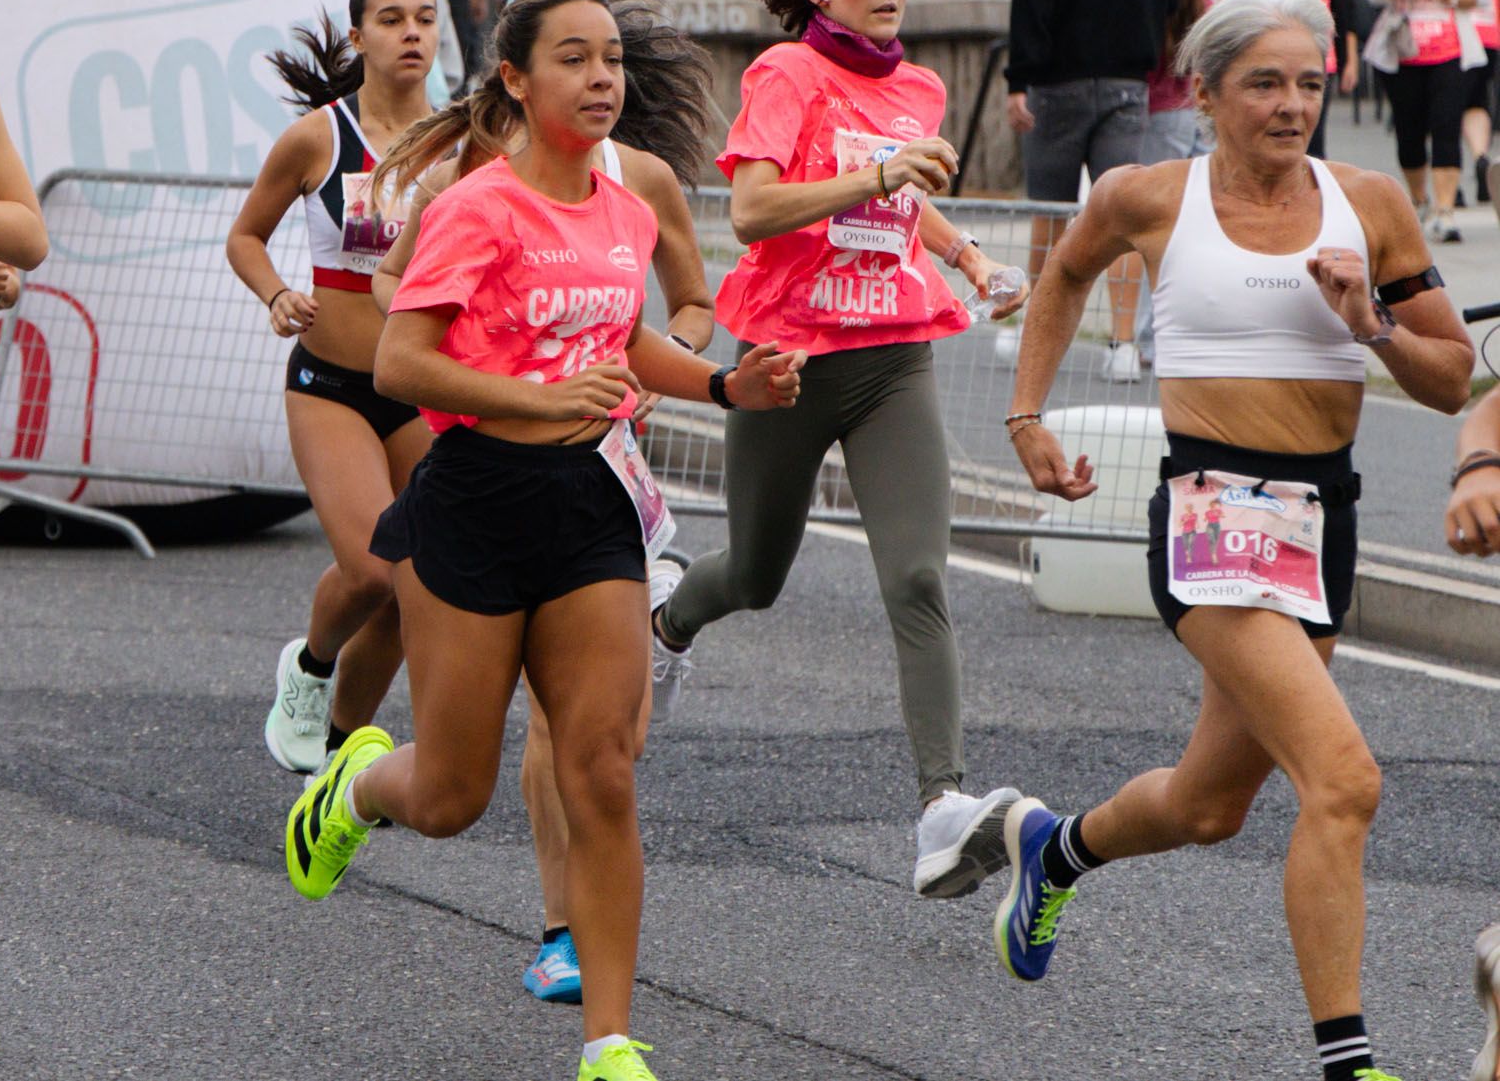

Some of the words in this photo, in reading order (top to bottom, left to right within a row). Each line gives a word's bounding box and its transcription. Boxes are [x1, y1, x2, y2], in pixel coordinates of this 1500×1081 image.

[843, 231, 886, 244] OYSHO
[1245, 276, 1300, 289] OYSHO
[528, 287, 635, 327] CARRERA
[808, 278, 898, 315] MUJER
[1224, 531, 1278, 562] 016
[1188, 585, 1243, 597] OYSHO
